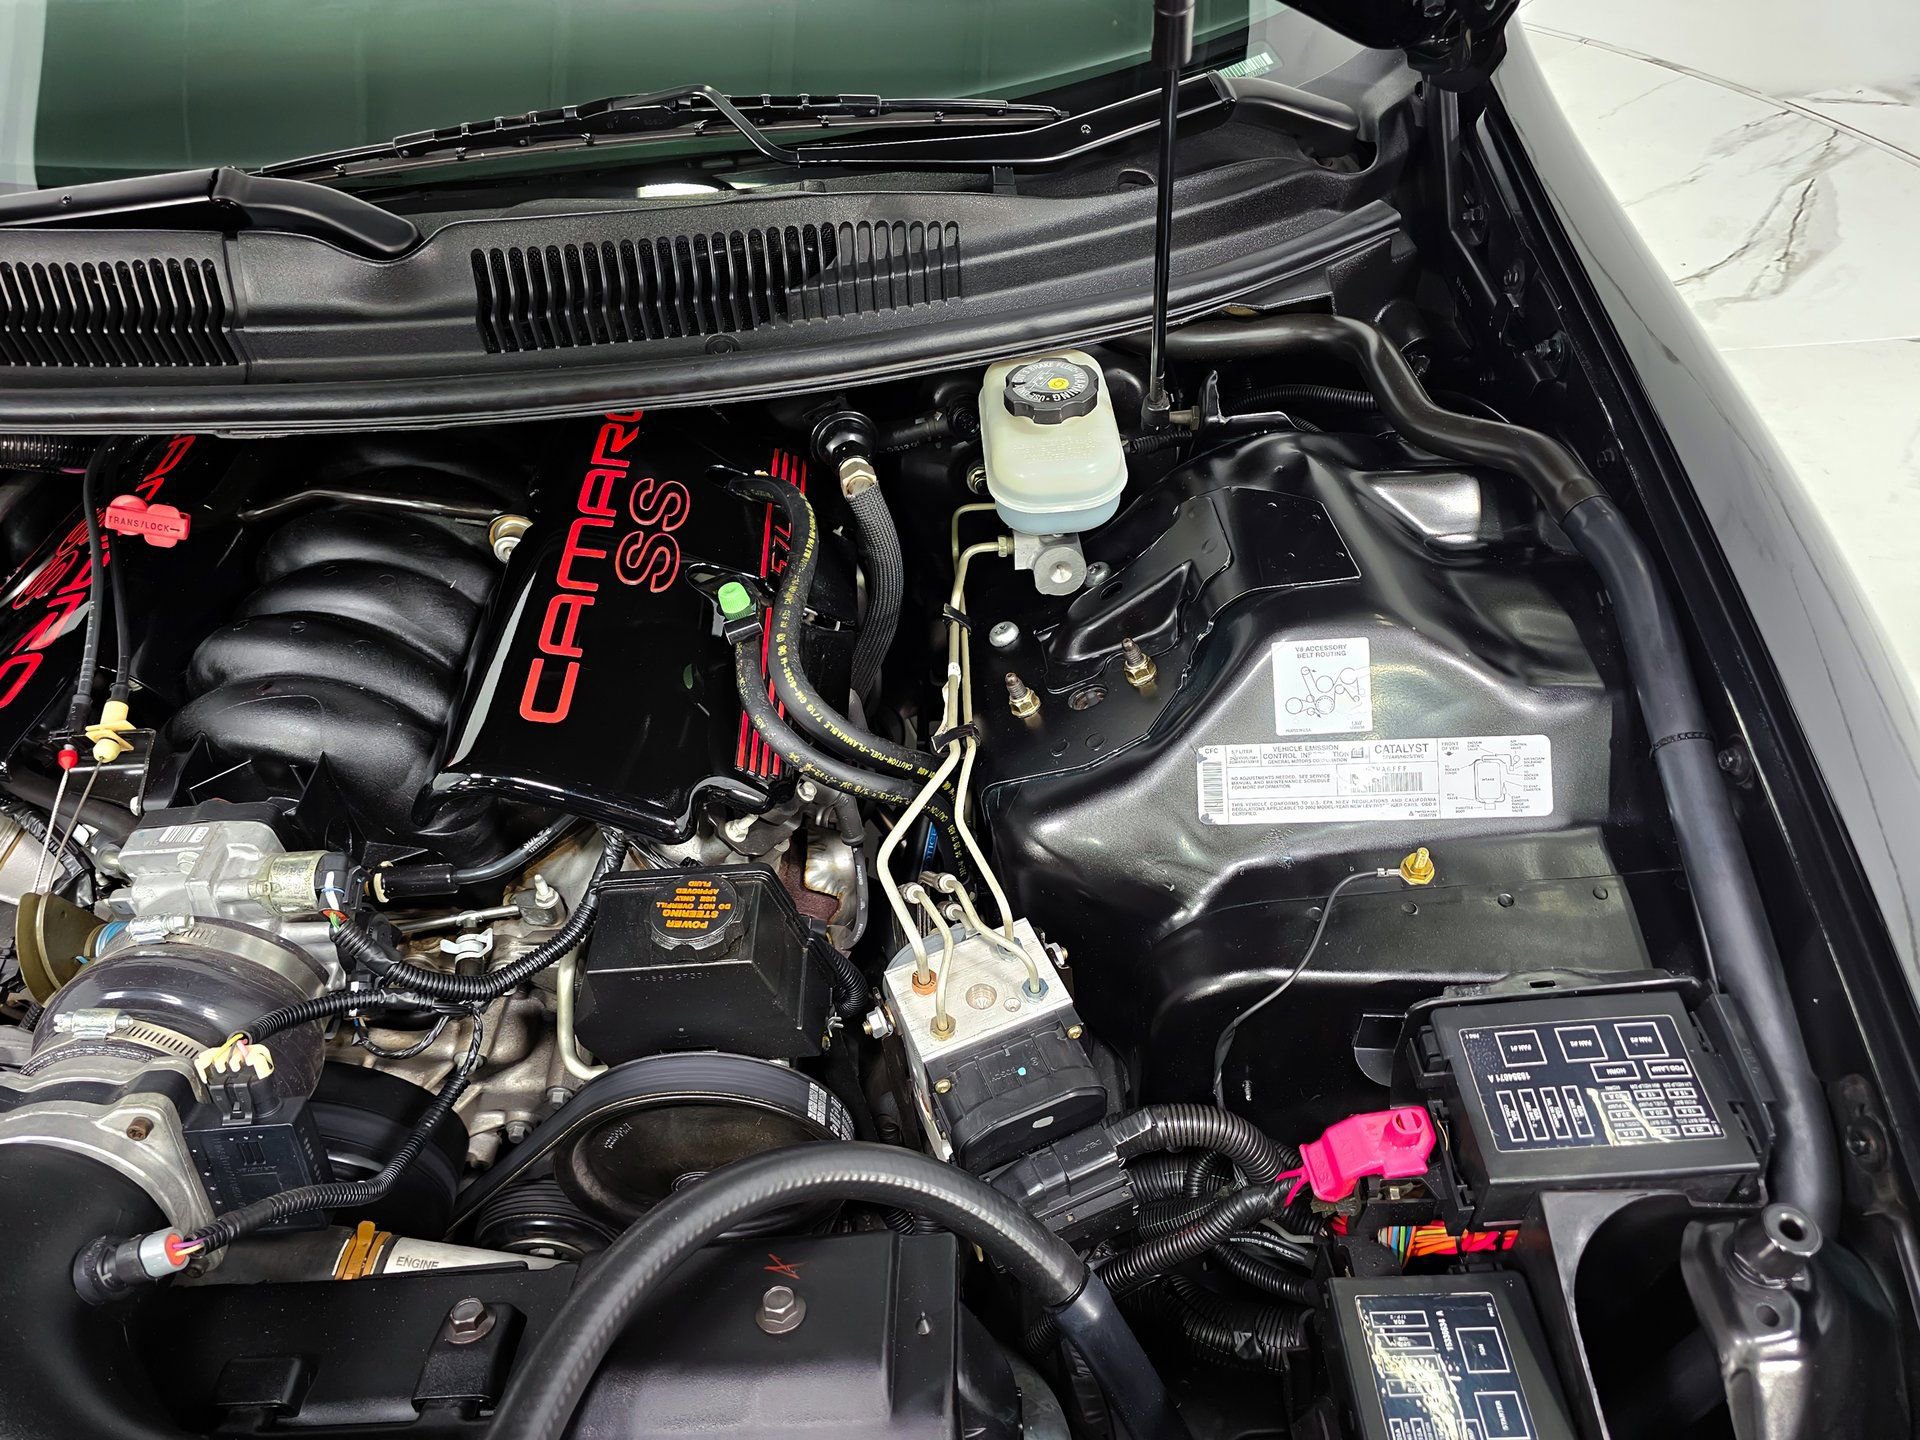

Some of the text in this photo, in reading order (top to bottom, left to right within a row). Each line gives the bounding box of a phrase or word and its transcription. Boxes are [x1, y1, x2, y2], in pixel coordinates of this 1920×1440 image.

[1029, 361, 1053, 372] BRAKE
[1053, 371, 1086, 402] WARNING
[108, 515, 170, 532] TRANS/LOCK
[615, 478, 691, 593] SS
[519, 410, 643, 724] CAMAR
[1305, 644, 1347, 652] ACCESSORY
[1315, 650, 1347, 658] ROUTING
[806, 704, 824, 723] 7/16
[823, 720, 914, 771] CAUTION-FUEL-FLAMMABLE
[1374, 743, 1429, 753] CATALYST
[1300, 751, 1350, 759] INFTION
[675, 887, 720, 895] APPROVED
[655, 901, 695, 909] OVERFILL
[662, 909, 719, 919] STEERING
[665, 919, 709, 929] POWER
[1606, 1067, 1627, 1075] HORN
[1487, 1074, 1494, 1083] A
[396, 1255, 440, 1270] ENGINE
[1494, 1400, 1510, 1432] STARTER
